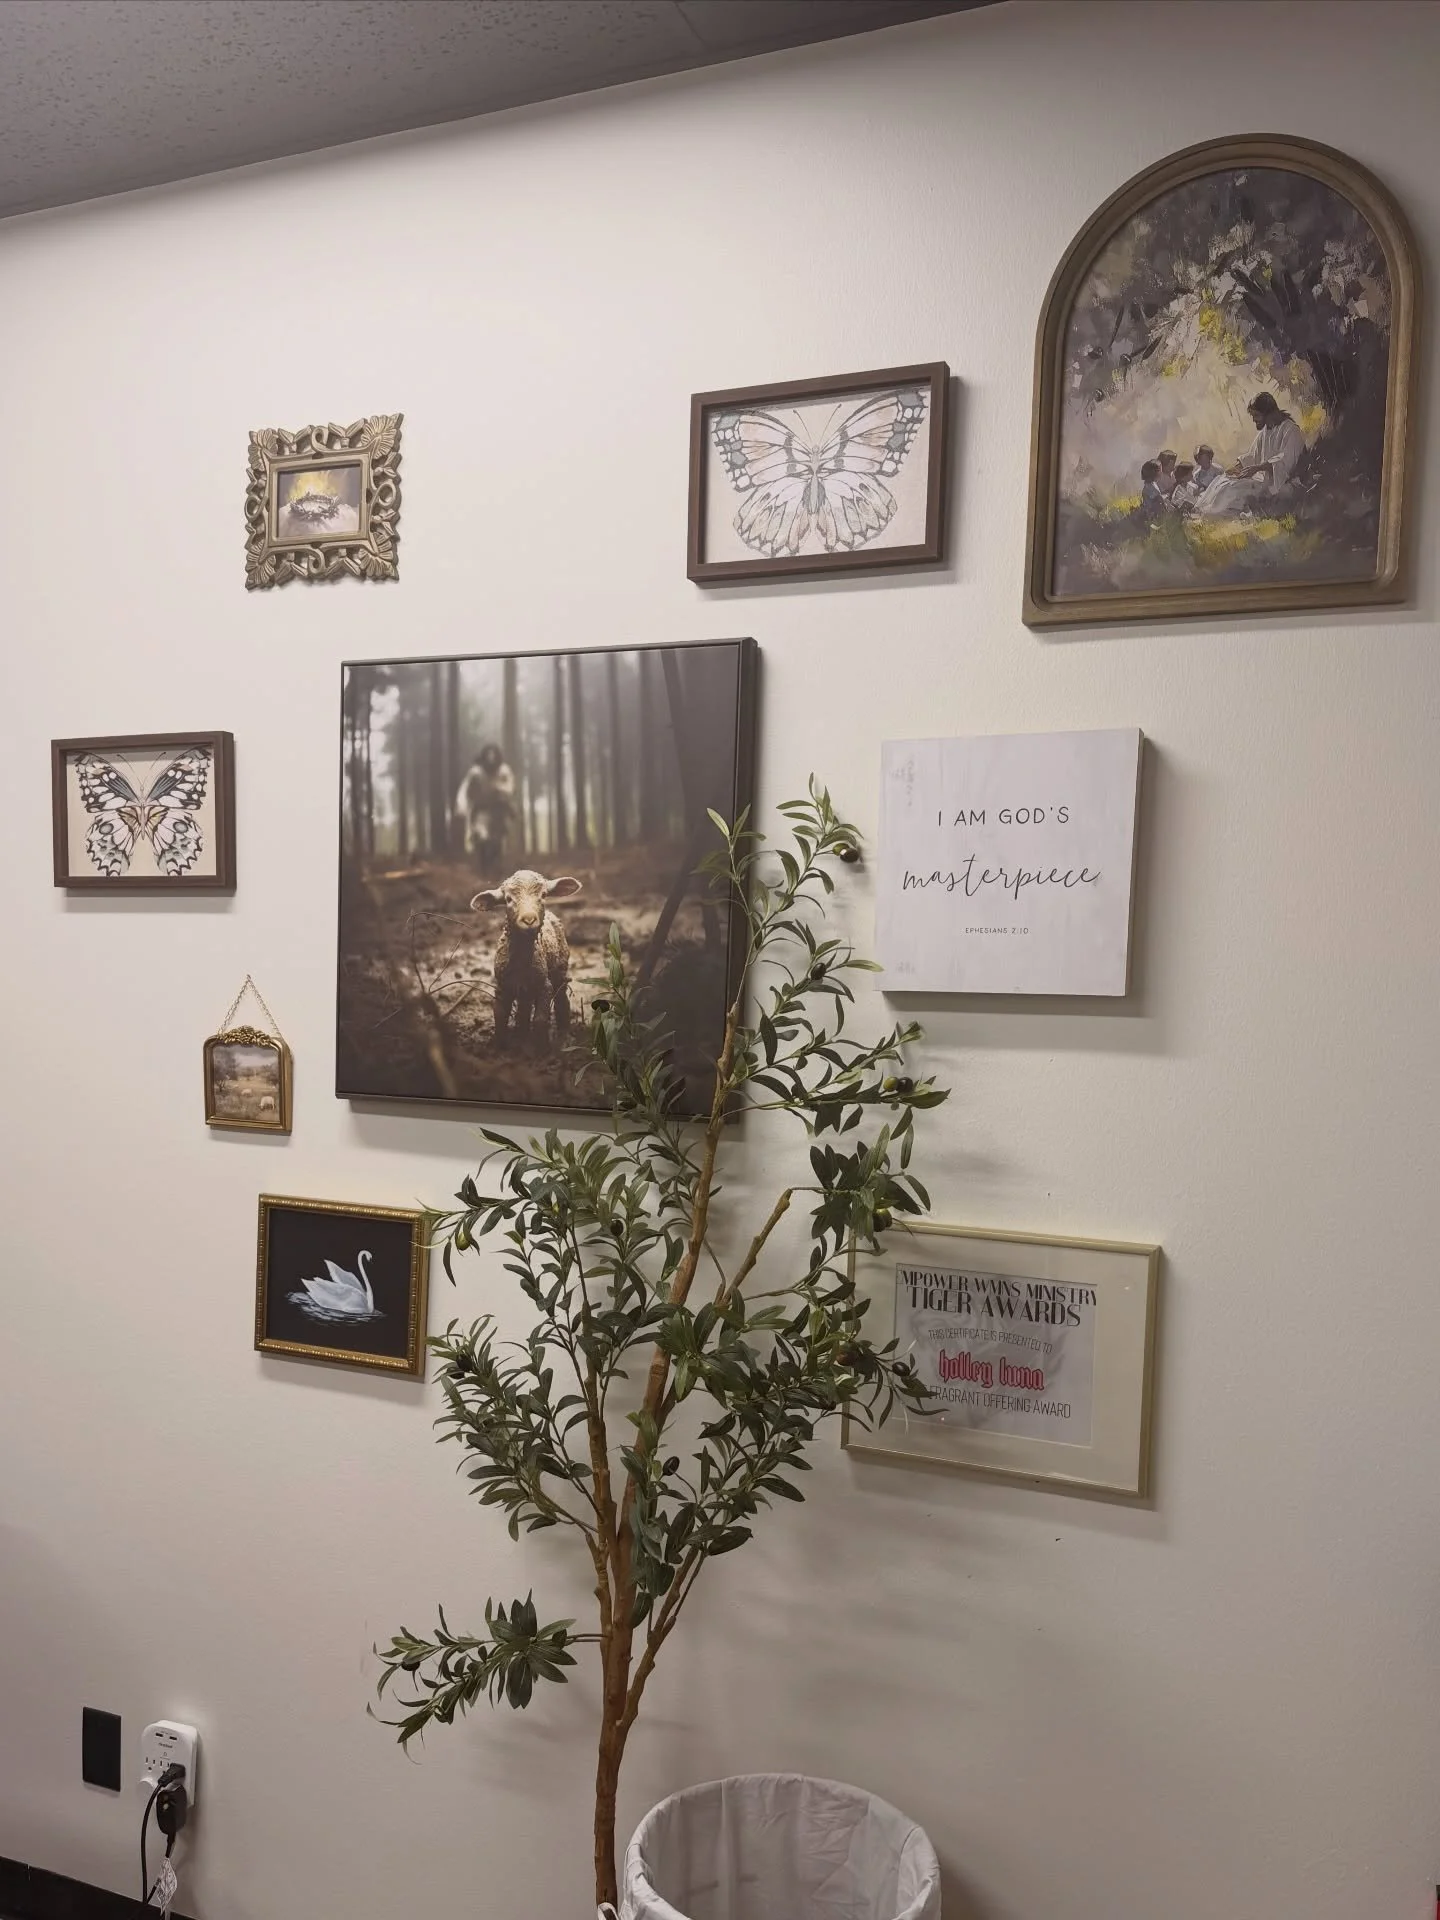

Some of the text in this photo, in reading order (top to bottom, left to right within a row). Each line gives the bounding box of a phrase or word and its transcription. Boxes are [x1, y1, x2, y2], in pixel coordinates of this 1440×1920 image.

[938, 806, 1070, 827] I AM GOD'S
[903, 853, 1101, 900] masterpiece
[965, 927, 1029, 935] EPHESIANS 2:10
[974, 1277, 1021, 1298] WMNS
[906, 1286, 1081, 1327] TIGER AWARDS
[928, 1328, 1053, 1353] THIS CERTIFICATE IS PRESENTED TO
[939, 1349, 1045, 1391] holley luna
[930, 1386, 1071, 1418] FRAGRANT OFFERING AWARD
